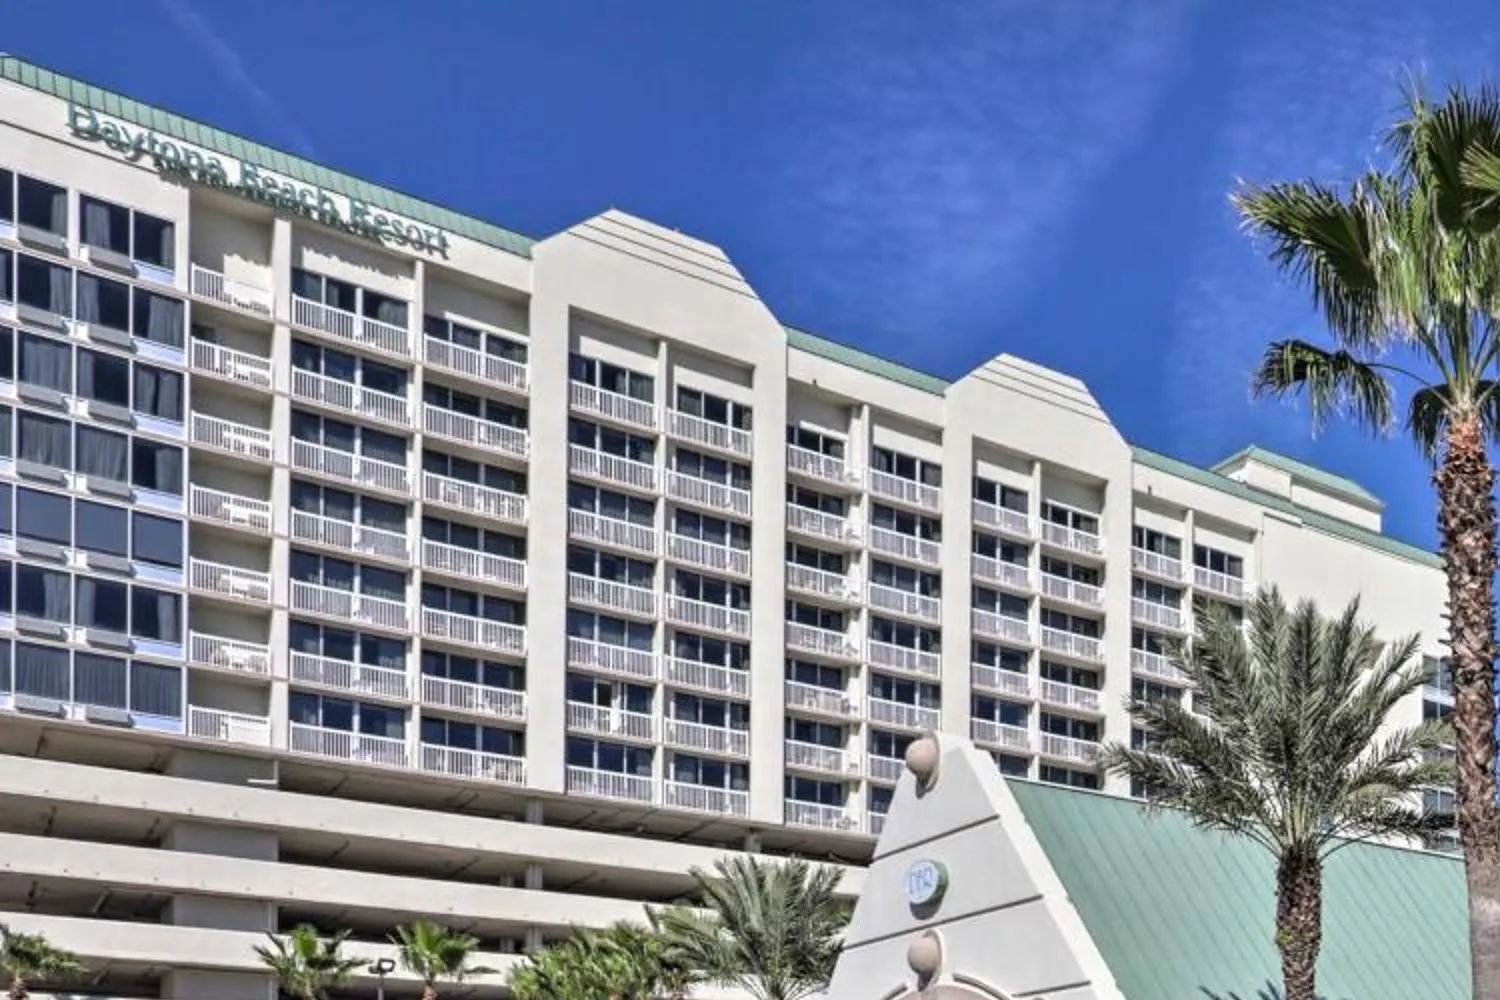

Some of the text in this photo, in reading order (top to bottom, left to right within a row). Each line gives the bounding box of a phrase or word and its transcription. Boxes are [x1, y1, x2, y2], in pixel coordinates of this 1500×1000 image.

[67, 101, 449, 260] Daytona Beach Resort
